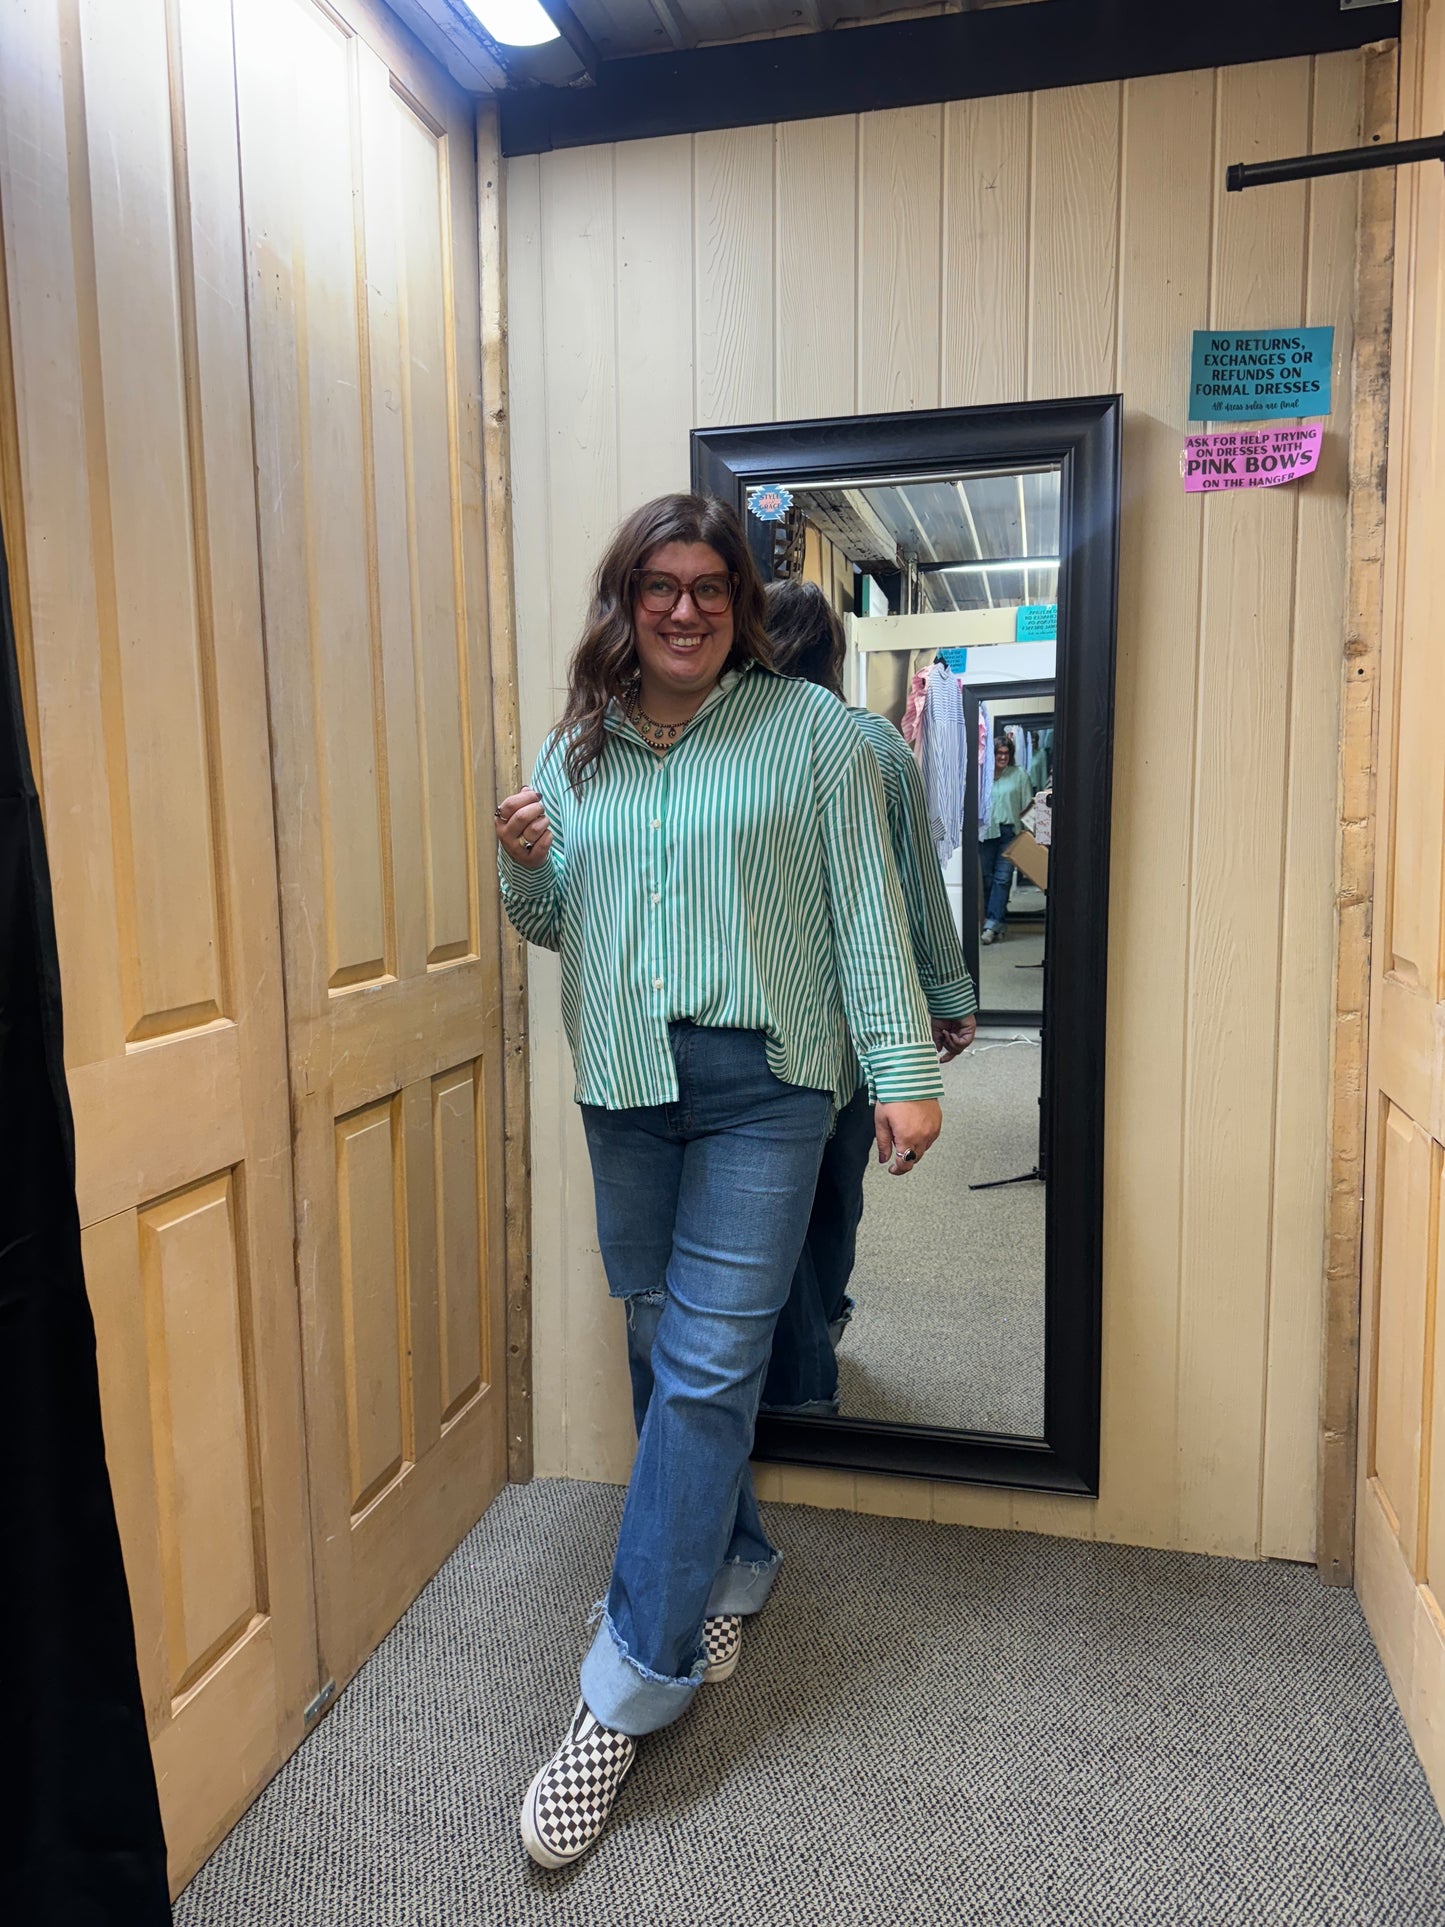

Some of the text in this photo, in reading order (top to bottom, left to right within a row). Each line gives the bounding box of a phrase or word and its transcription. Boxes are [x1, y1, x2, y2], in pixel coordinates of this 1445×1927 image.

[1211, 337, 1305, 351] NO RETURNS,
[1204, 352, 1313, 366] EXCHANGES OR
[1212, 367, 1302, 381] REFUNDS ON
[1196, 380, 1320, 396] FORMAL DRESSES
[1225, 402, 1243, 411] dress
[1280, 399, 1299, 410] final
[1187, 429, 1317, 448] ASK FOR HELP TRYING
[1196, 442, 1302, 458] ON DRESSES WITH
[1187, 450, 1313, 476] PINK BOWS
[1202, 480, 1219, 488] ON
[1223, 479, 1244, 487] THE
